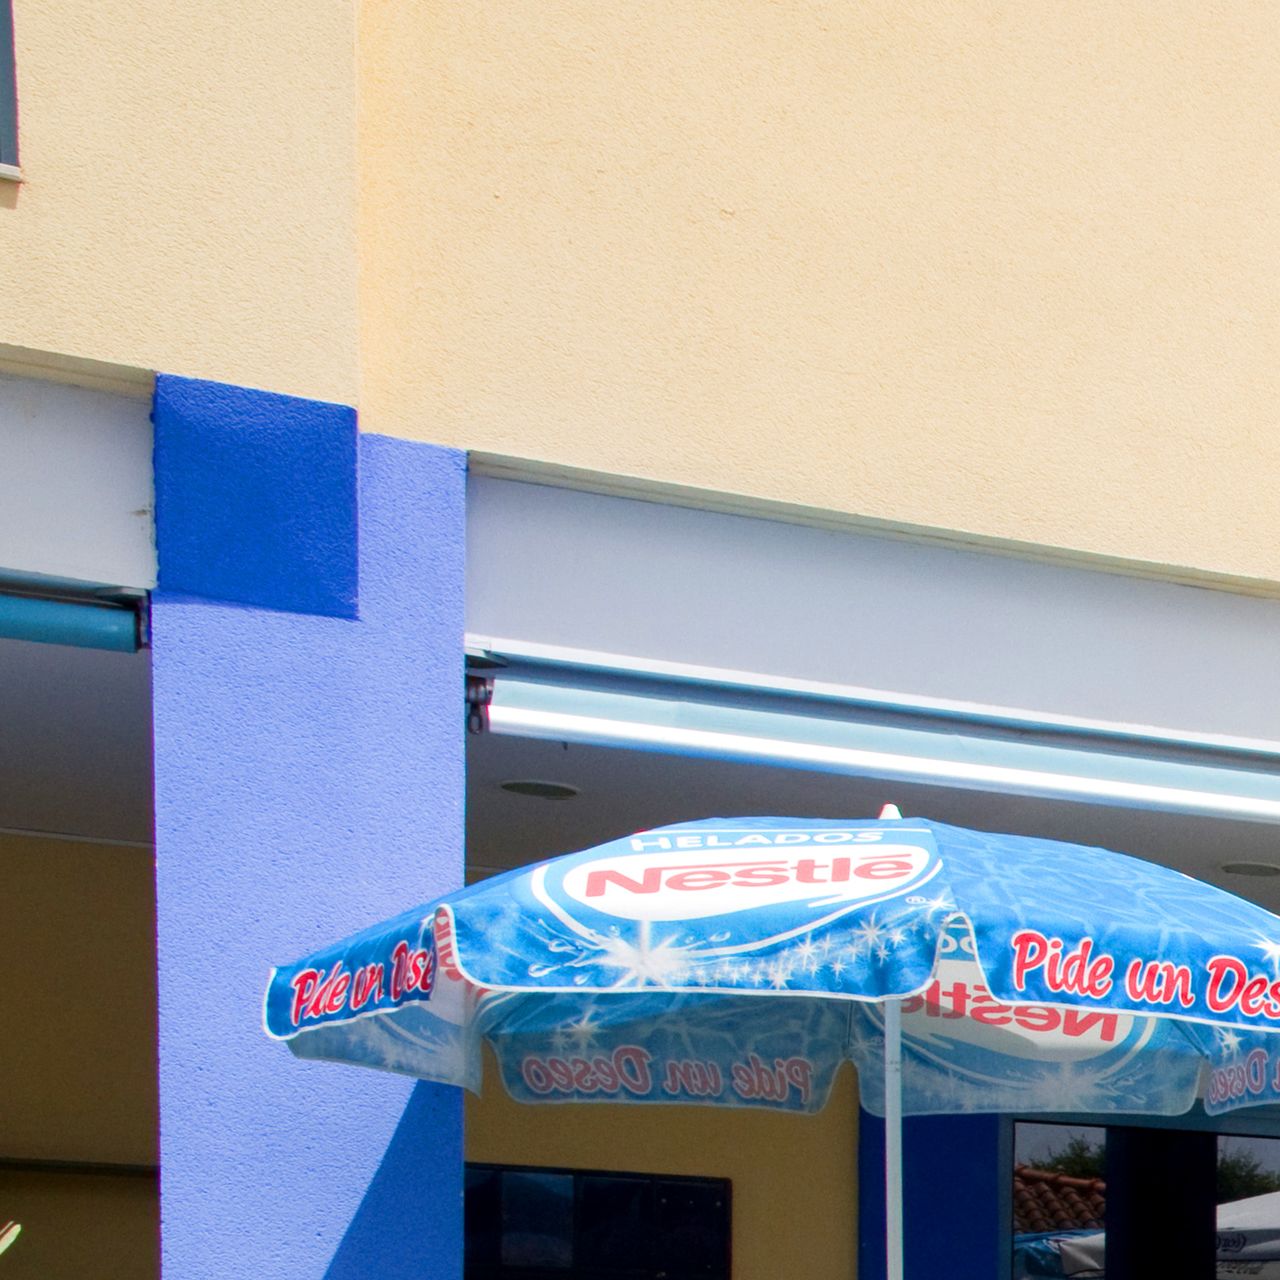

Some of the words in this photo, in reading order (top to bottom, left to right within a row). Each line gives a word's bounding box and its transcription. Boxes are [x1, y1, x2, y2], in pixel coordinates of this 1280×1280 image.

[629, 831, 885, 852] HELADOS
[1011, 930, 1115, 999] Pide
[1126, 958, 1195, 1008] un
